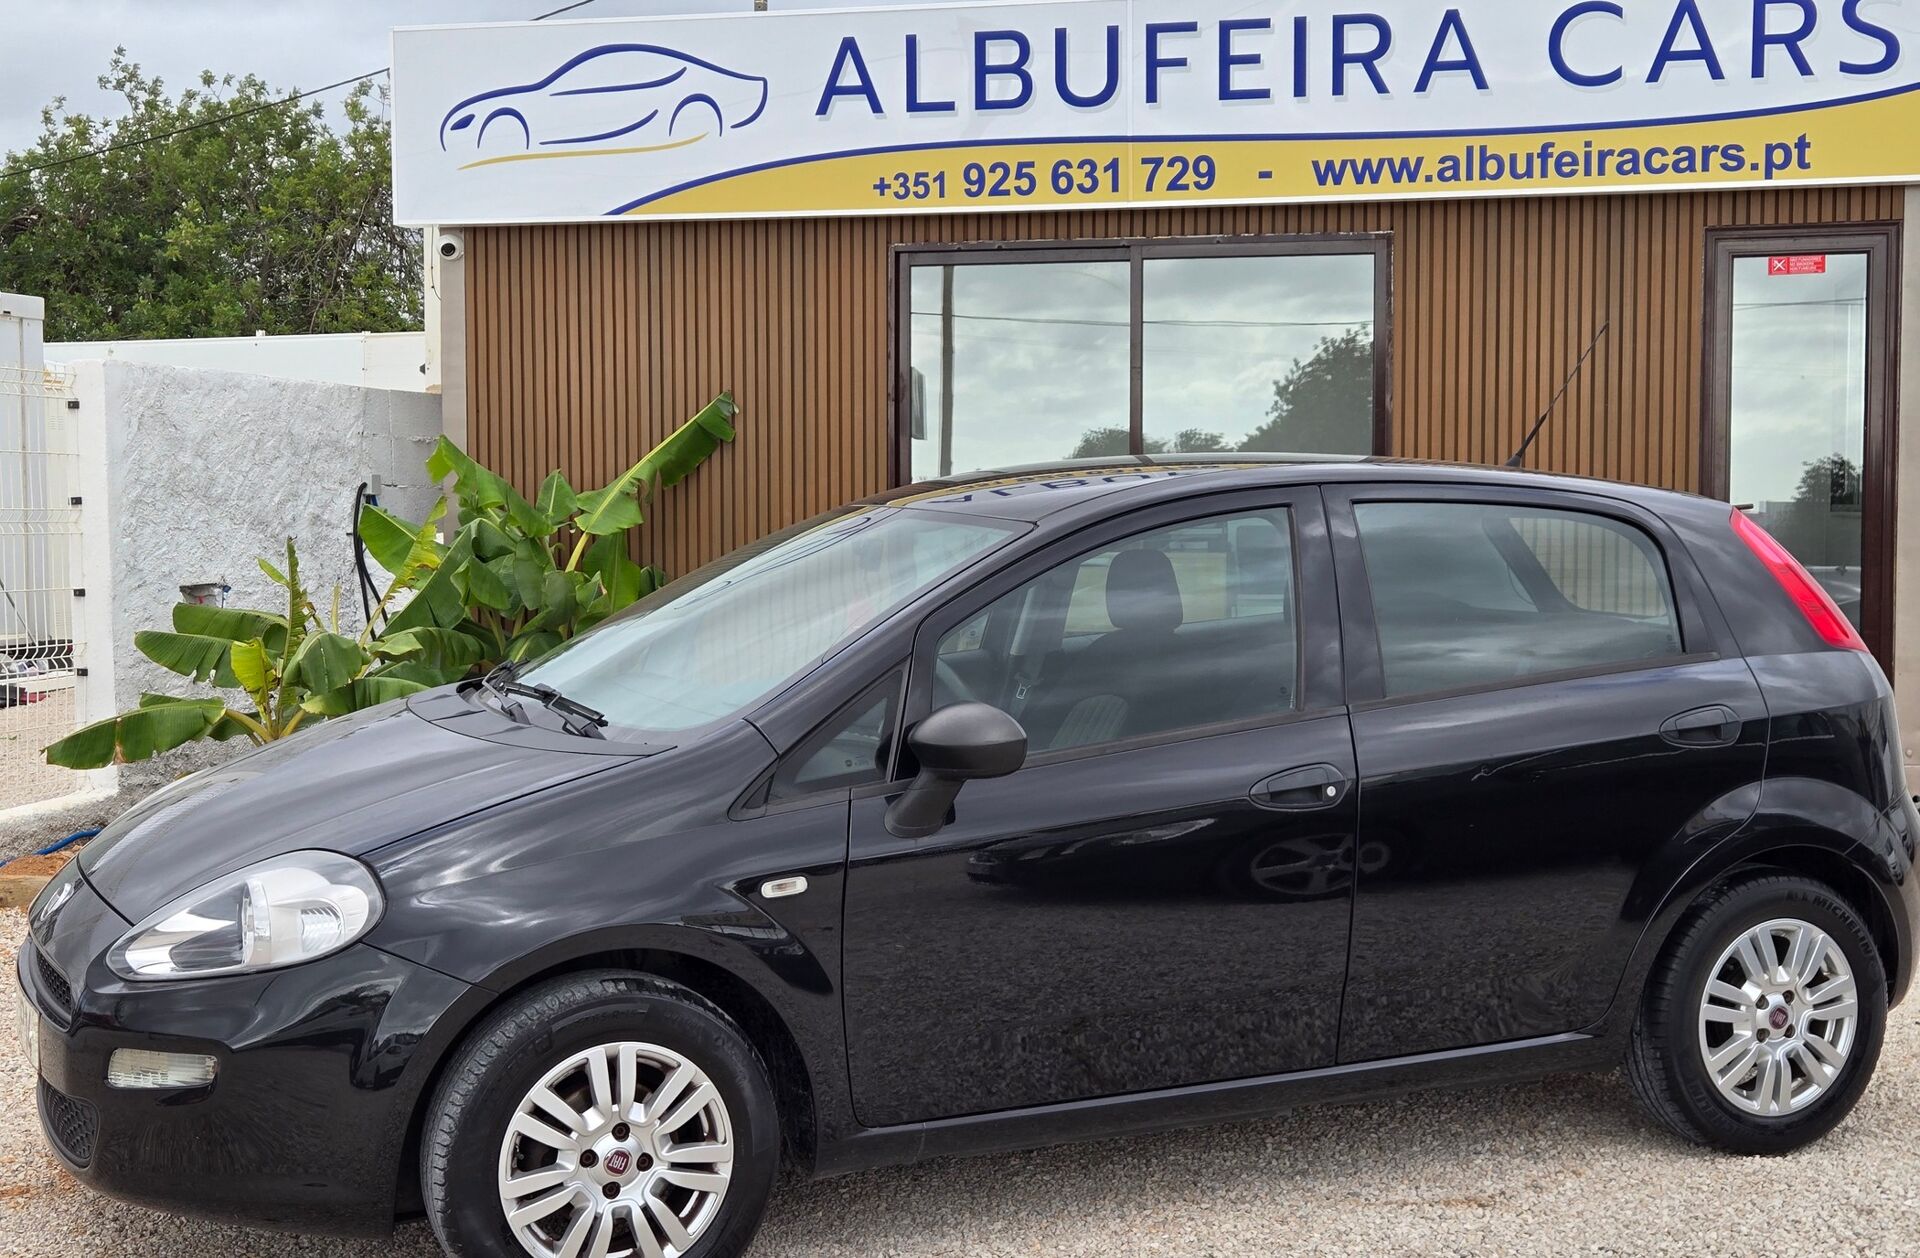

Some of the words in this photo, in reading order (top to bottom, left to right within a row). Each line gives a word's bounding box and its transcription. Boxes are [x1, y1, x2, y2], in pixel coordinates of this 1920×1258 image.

[815, 8, 1490, 117] ALBUFEIRA
[1548, 0, 1902, 88] CARS
[872, 171, 946, 200] +351
[963, 161, 1037, 198] 925
[1050, 158, 1121, 196] 631
[1140, 155, 1217, 192] 729
[1312, 133, 1812, 188] www.albufeiracars.pt
[608, 1154, 628, 1171] FIAT
